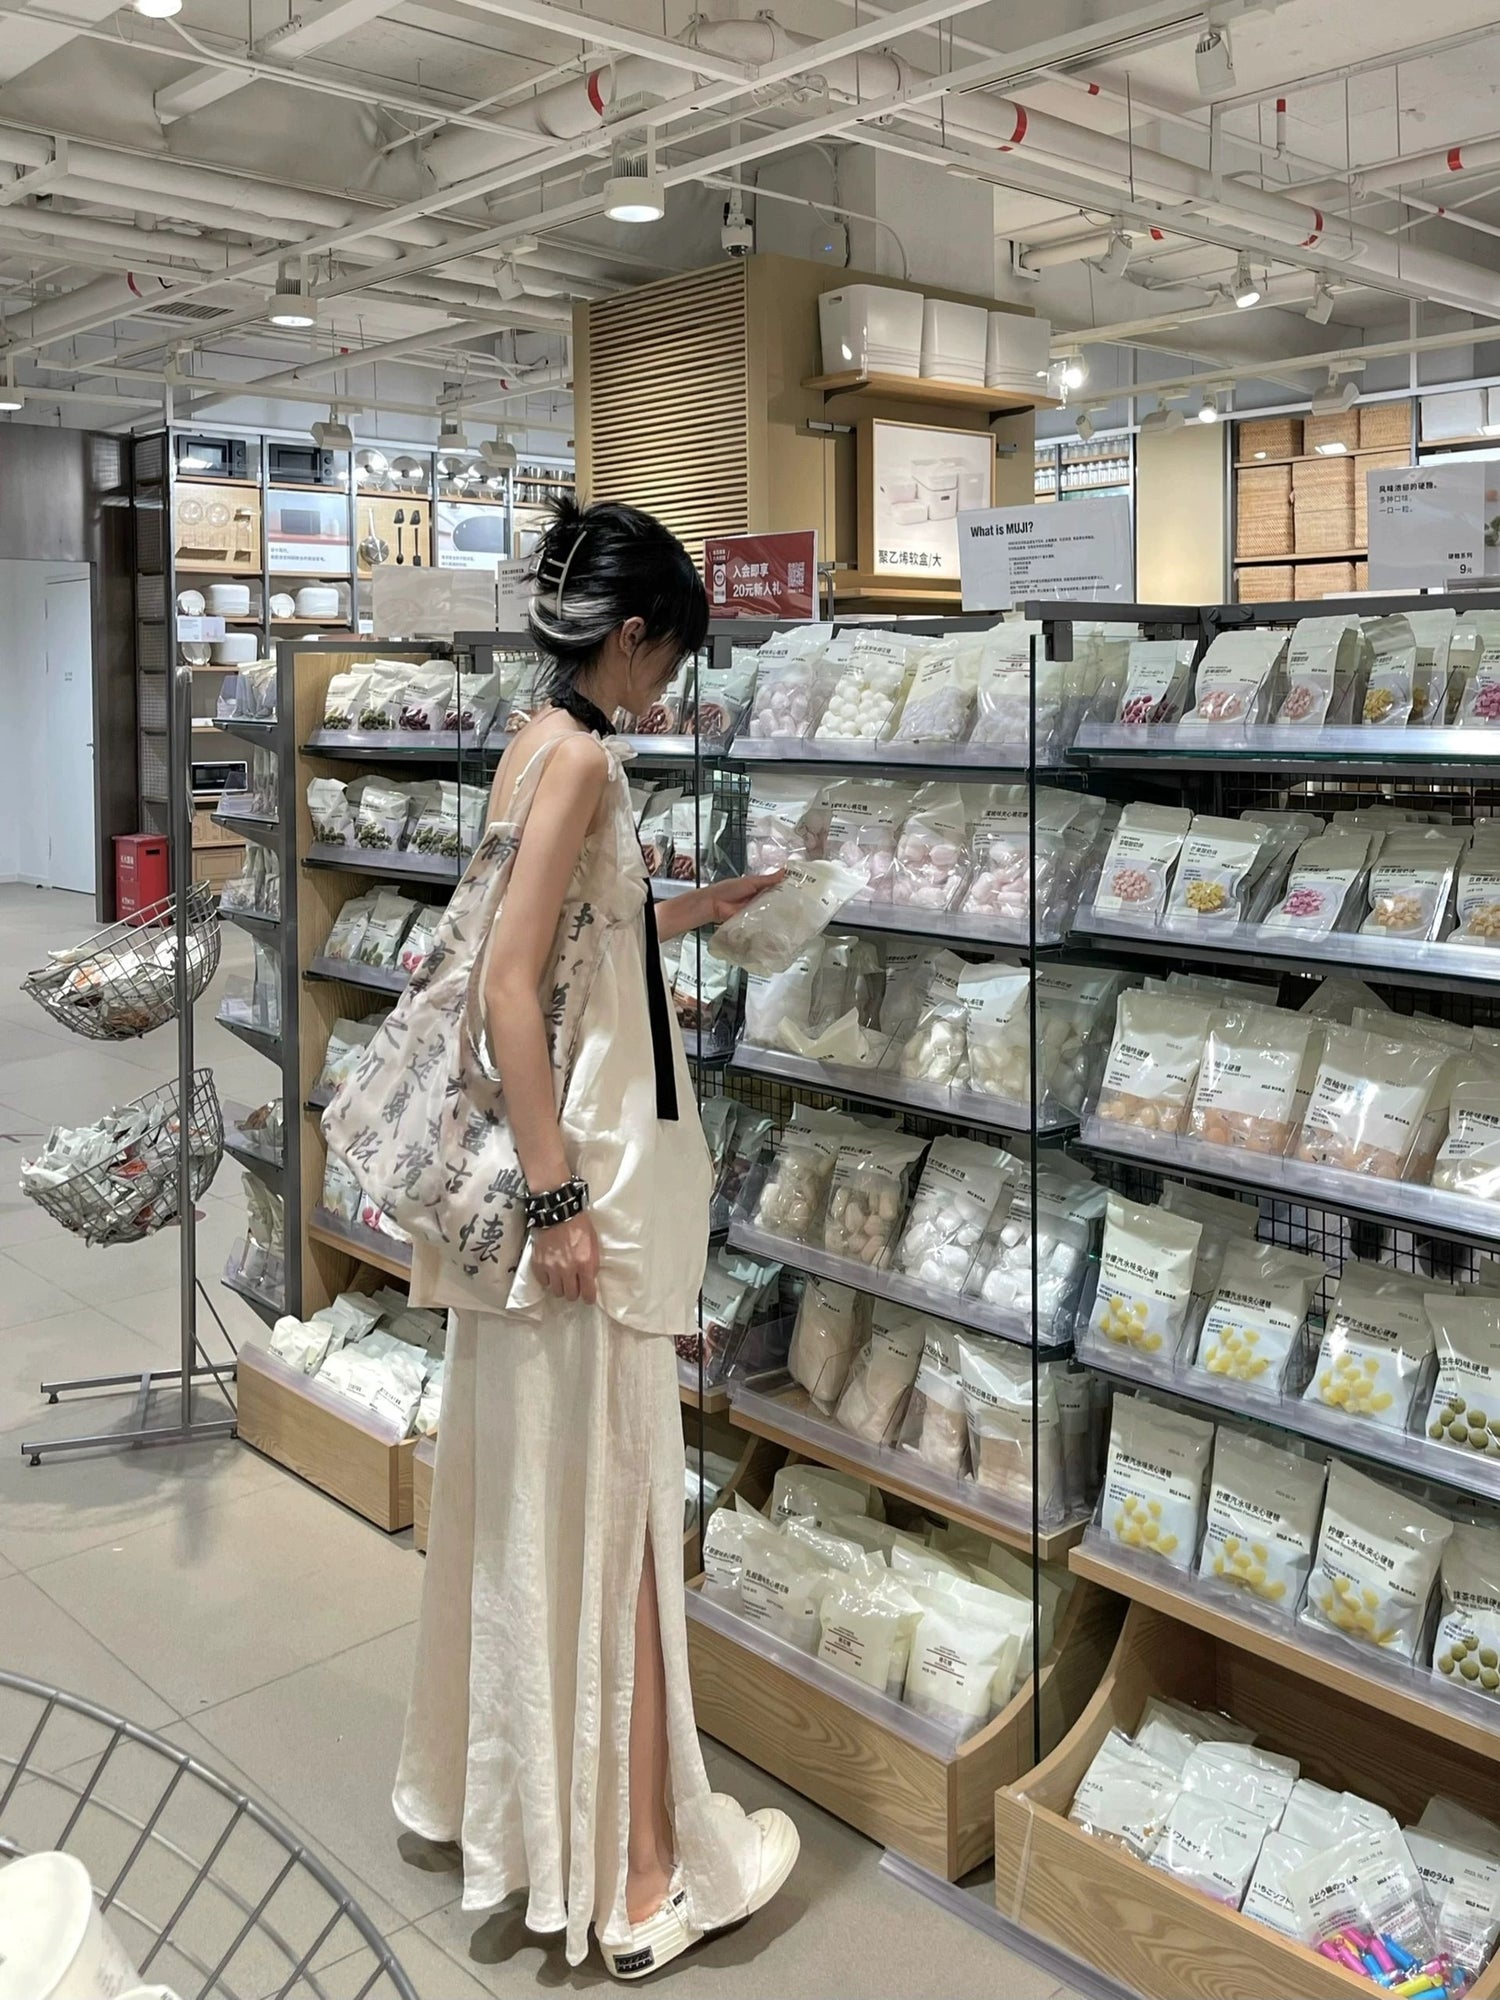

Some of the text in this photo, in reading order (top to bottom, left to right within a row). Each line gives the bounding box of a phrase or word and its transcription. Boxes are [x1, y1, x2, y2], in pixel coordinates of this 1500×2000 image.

[970, 521, 1034, 538] What is MUJI?
[878, 549, 942, 568] 聚乙烯软盒/大
[733, 563, 768, 578] 入会即享
[733, 581, 782, 597] 20元新人礼
[1219, 1288, 1272, 1309] 柠檬汽水味夹心硬糖
[1115, 1452, 1173, 1479] 柠檬汽水味夹心硬糖
[1216, 1490, 1280, 1522] 柠檬汽水味夹心硬糖
